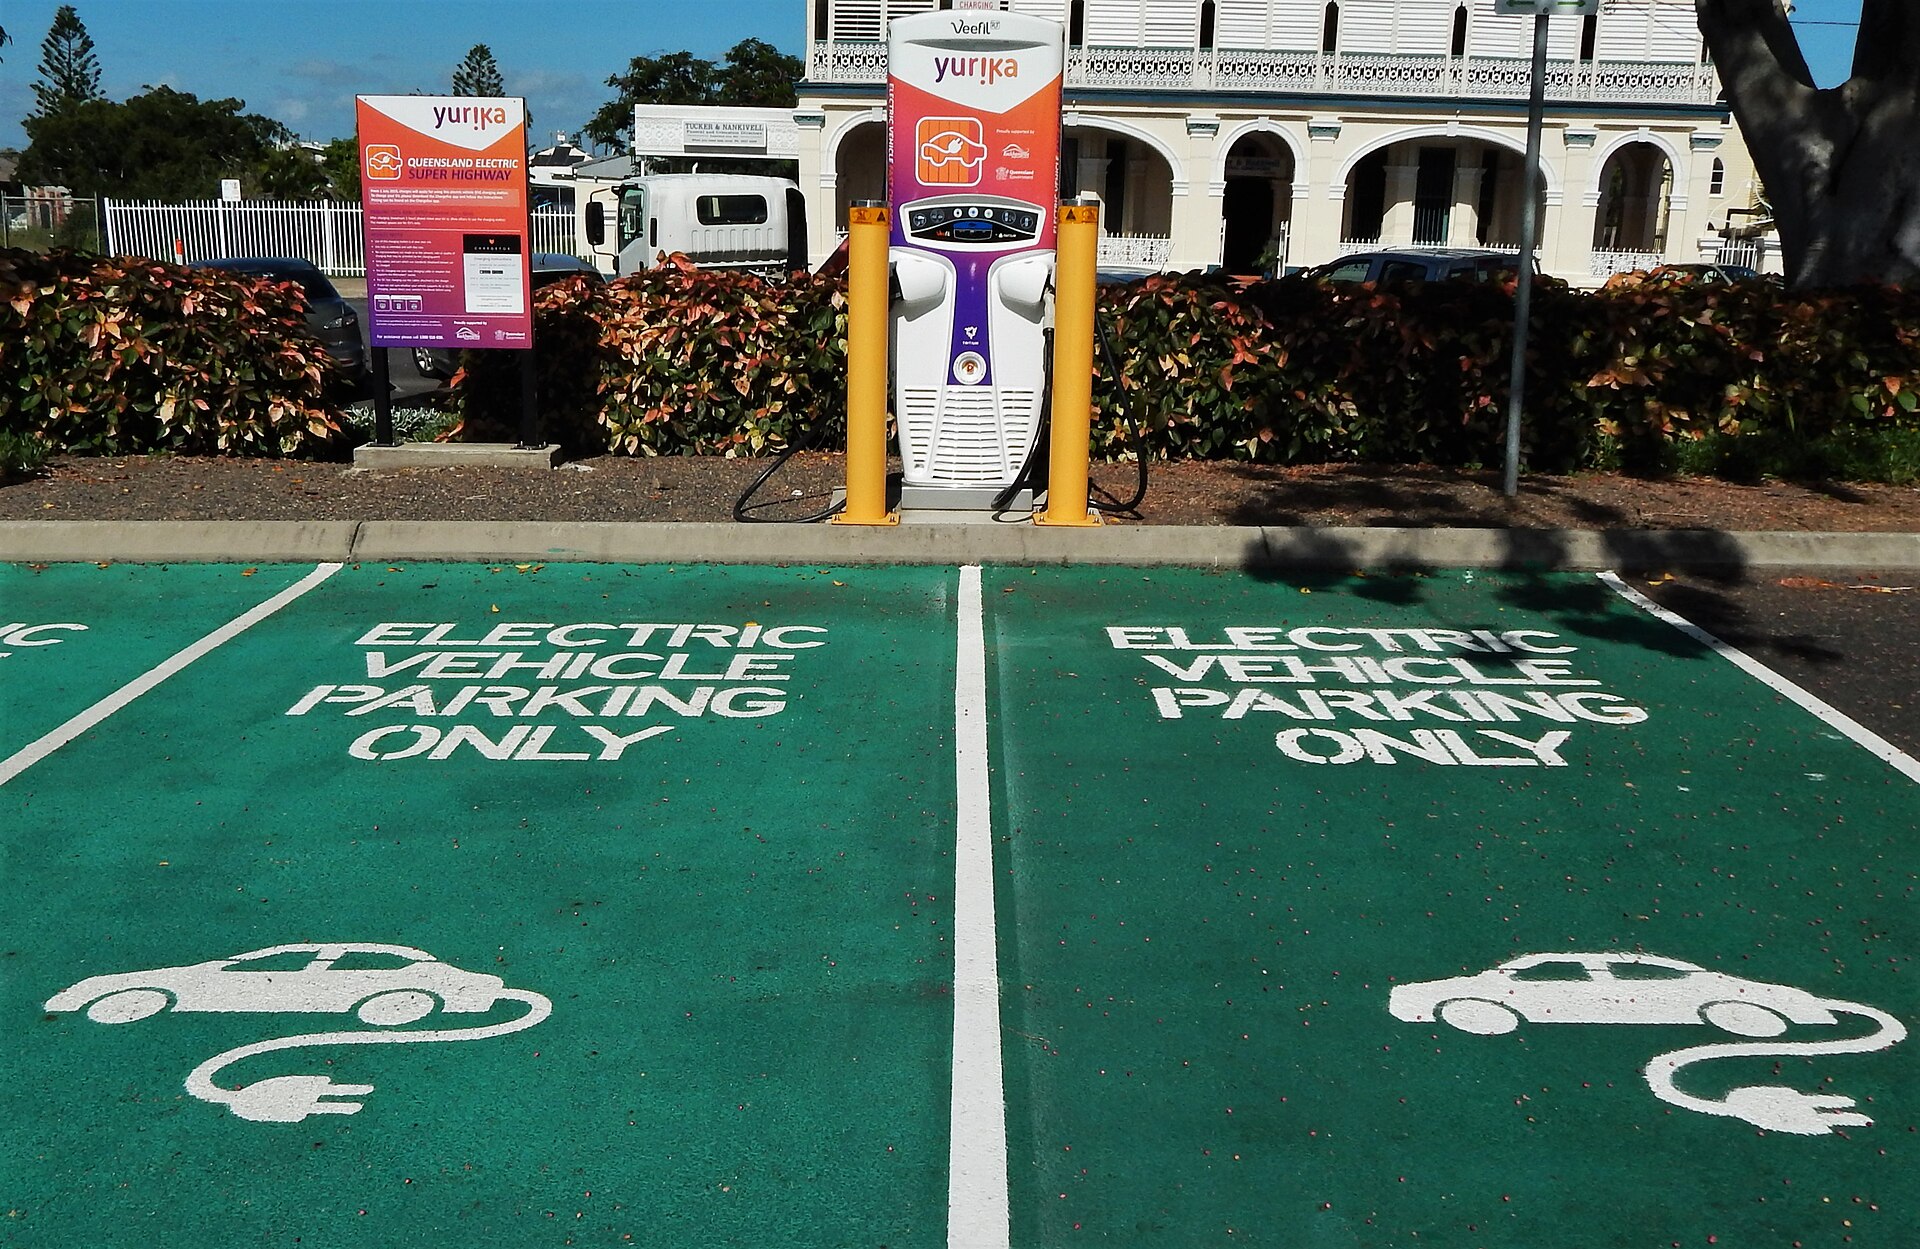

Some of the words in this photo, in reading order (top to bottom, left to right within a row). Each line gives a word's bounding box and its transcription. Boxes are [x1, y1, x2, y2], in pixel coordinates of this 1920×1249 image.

[960, 1, 993, 9] CHARGING
[951, 19, 990, 34] Veefil
[407, 158, 473, 168] QUEENSLAND
[475, 158, 519, 168] ELECTRIC
[408, 168, 447, 180] SUPER
[451, 169, 511, 181] HIGHWAY
[354, 623, 828, 648] ELECTRIC
[1103, 626, 1578, 653] ELECTRIC
[366, 652, 795, 680] VEHICLE
[1142, 655, 1601, 685] VEHICLE
[285, 684, 787, 718] PARKING
[1150, 687, 1649, 724] PARKING
[348, 725, 675, 760] ONLY
[1275, 728, 1572, 767] ONLY
